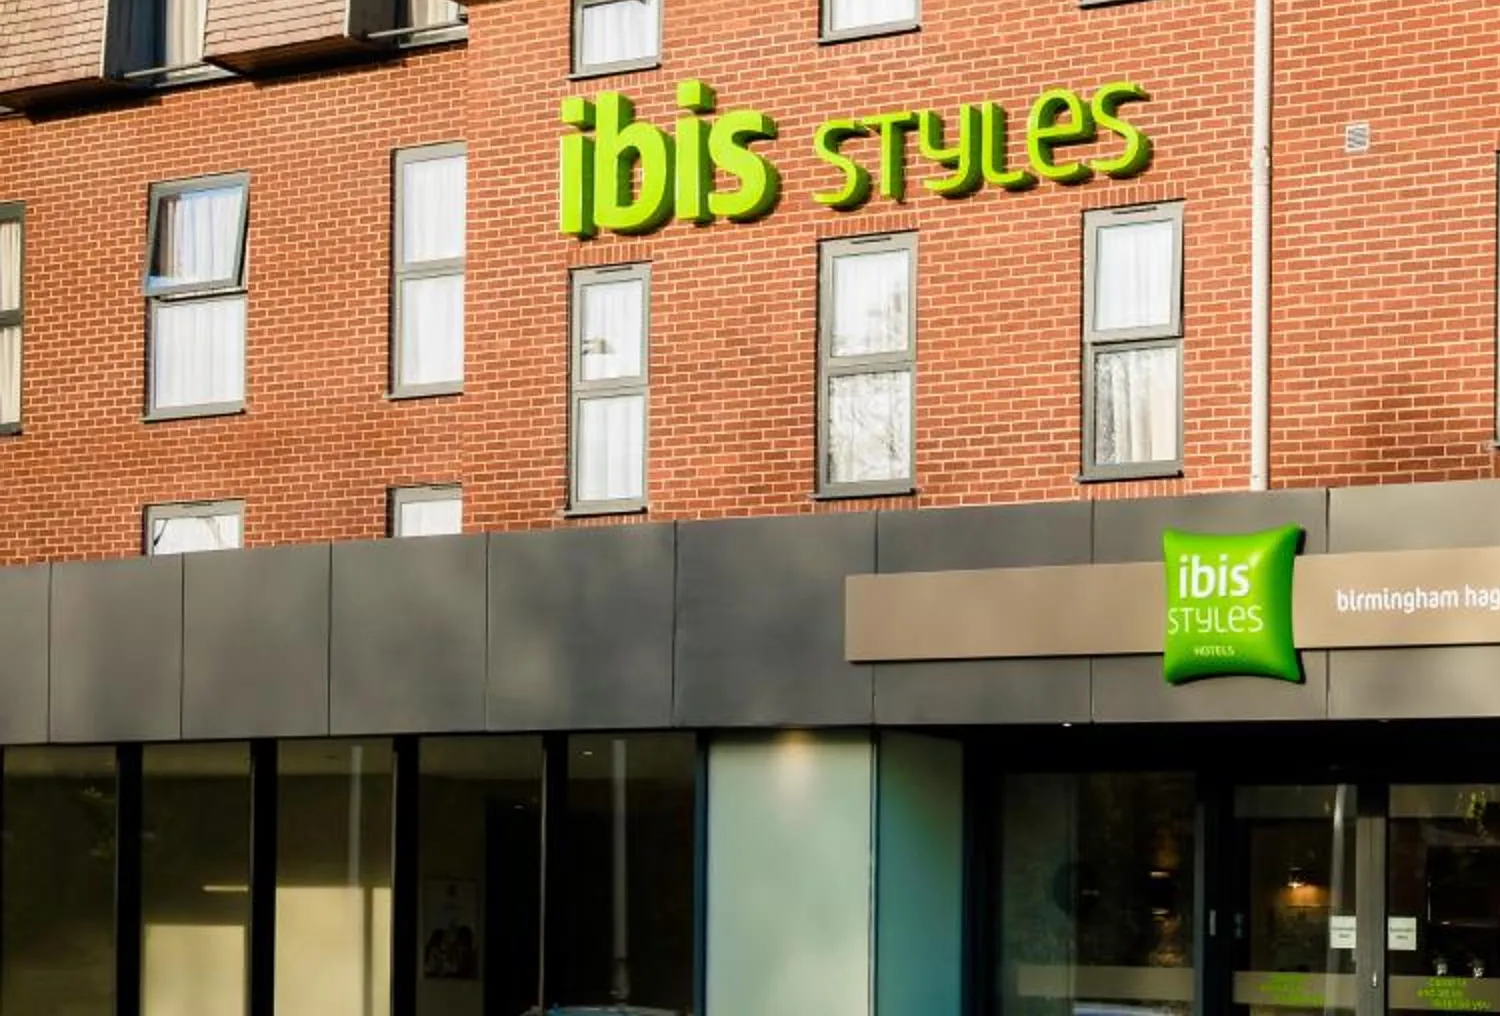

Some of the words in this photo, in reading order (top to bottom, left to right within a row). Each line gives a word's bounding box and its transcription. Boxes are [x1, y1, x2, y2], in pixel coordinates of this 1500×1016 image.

[559, 78, 781, 238] ibis
[1179, 553, 1251, 599] ibis
[1336, 586, 1460, 614] birmingham
[1193, 644, 1235, 657] HOTELS
